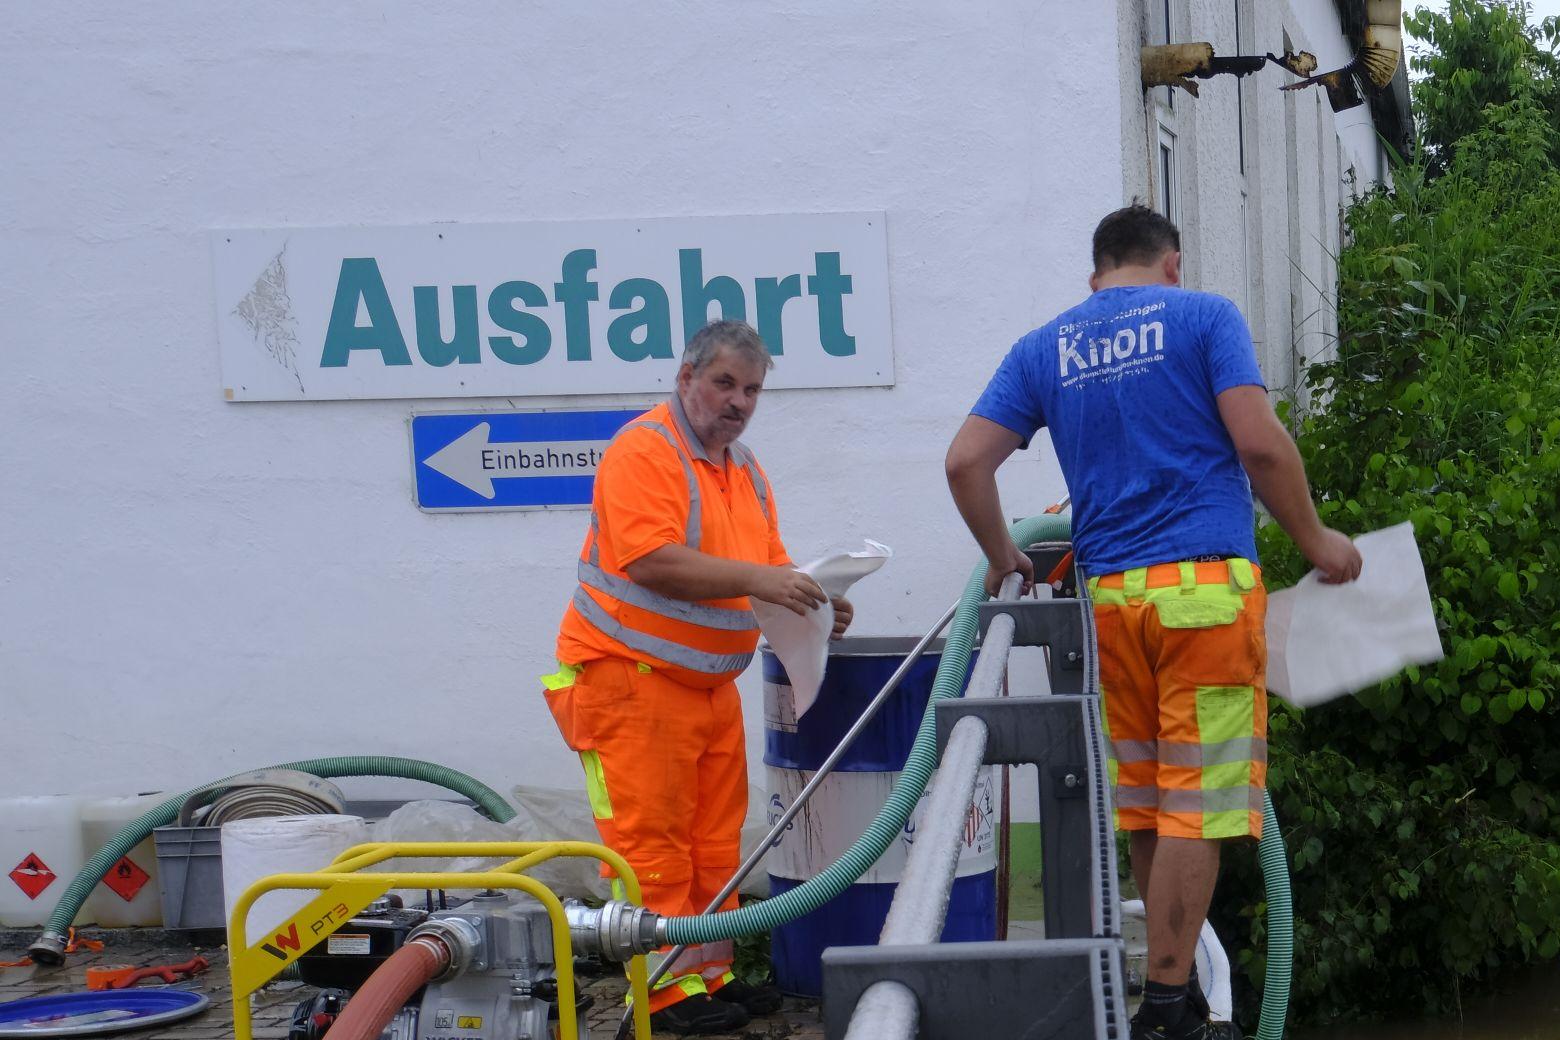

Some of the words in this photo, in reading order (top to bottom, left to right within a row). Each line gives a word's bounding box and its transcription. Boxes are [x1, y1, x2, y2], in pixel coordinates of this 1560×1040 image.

[319, 248, 857, 368] Ausfahrt
[1059, 321, 1164, 378] Knon
[310, 903, 349, 936] PT3
